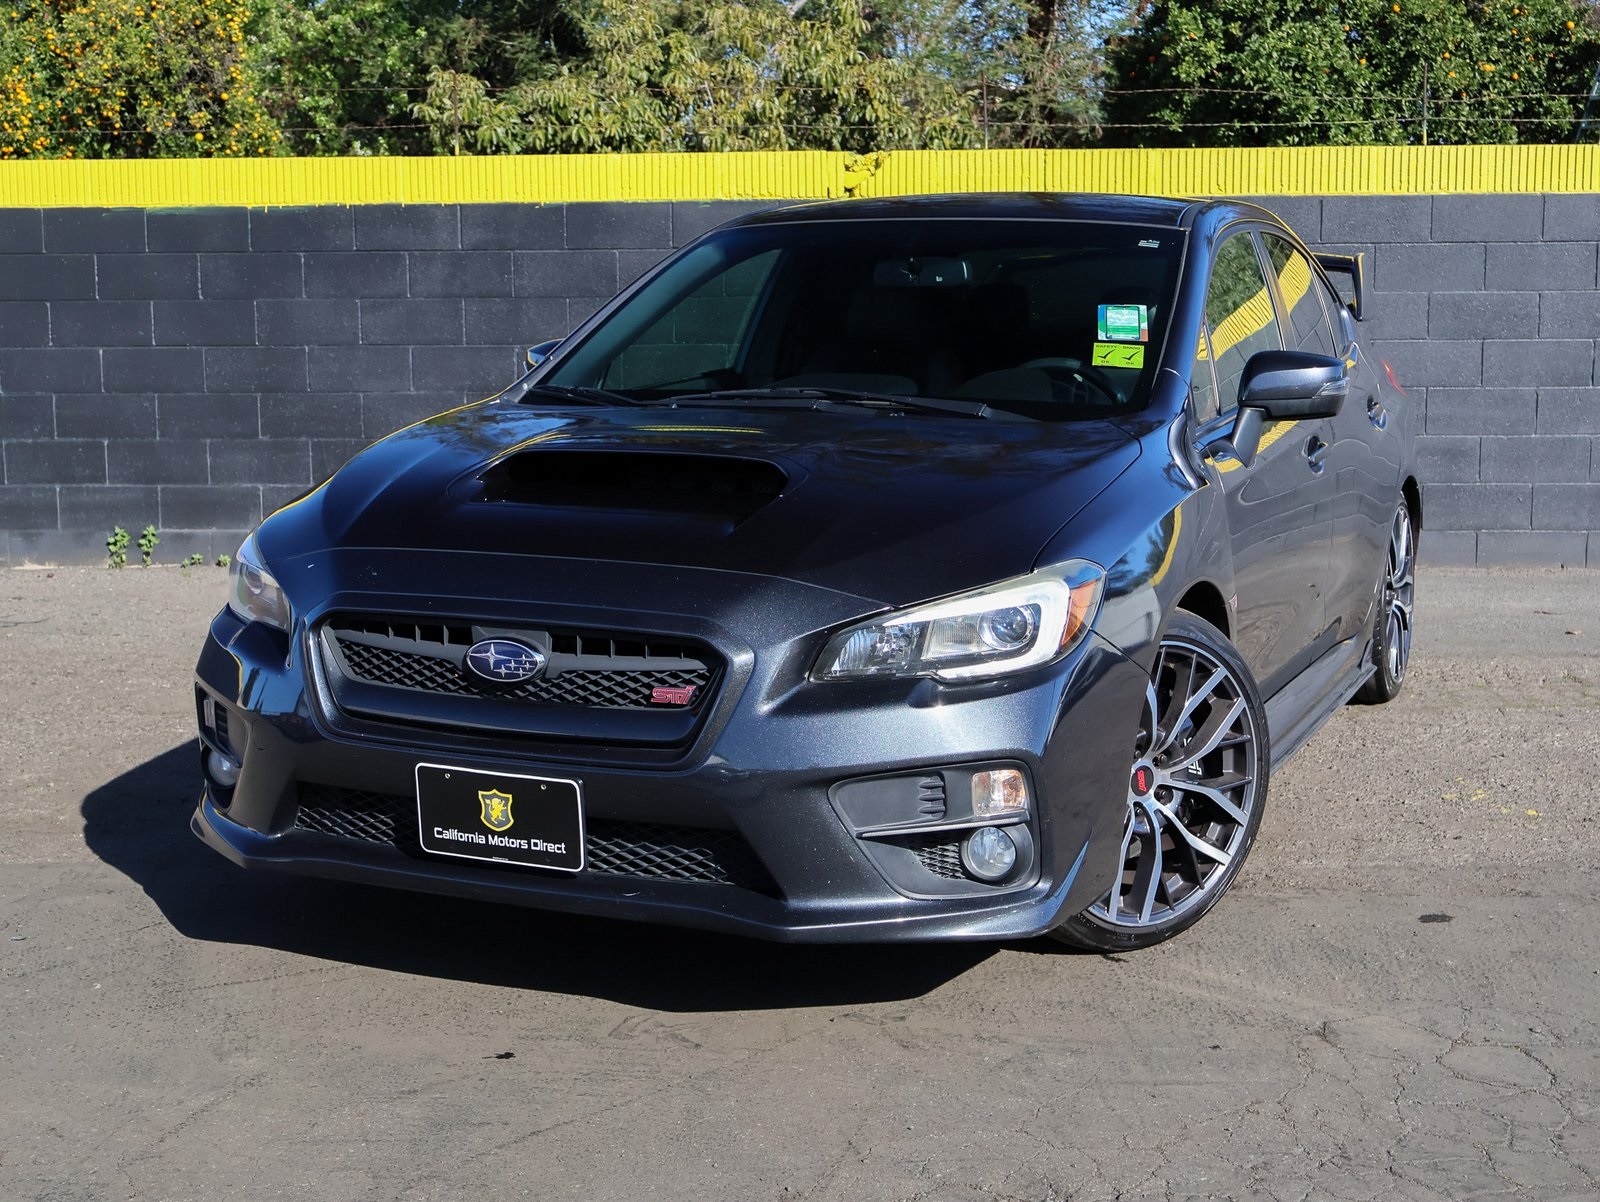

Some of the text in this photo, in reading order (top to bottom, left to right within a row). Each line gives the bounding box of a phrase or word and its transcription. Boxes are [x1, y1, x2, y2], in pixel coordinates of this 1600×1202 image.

[434, 827, 567, 854] California Motors Direct
